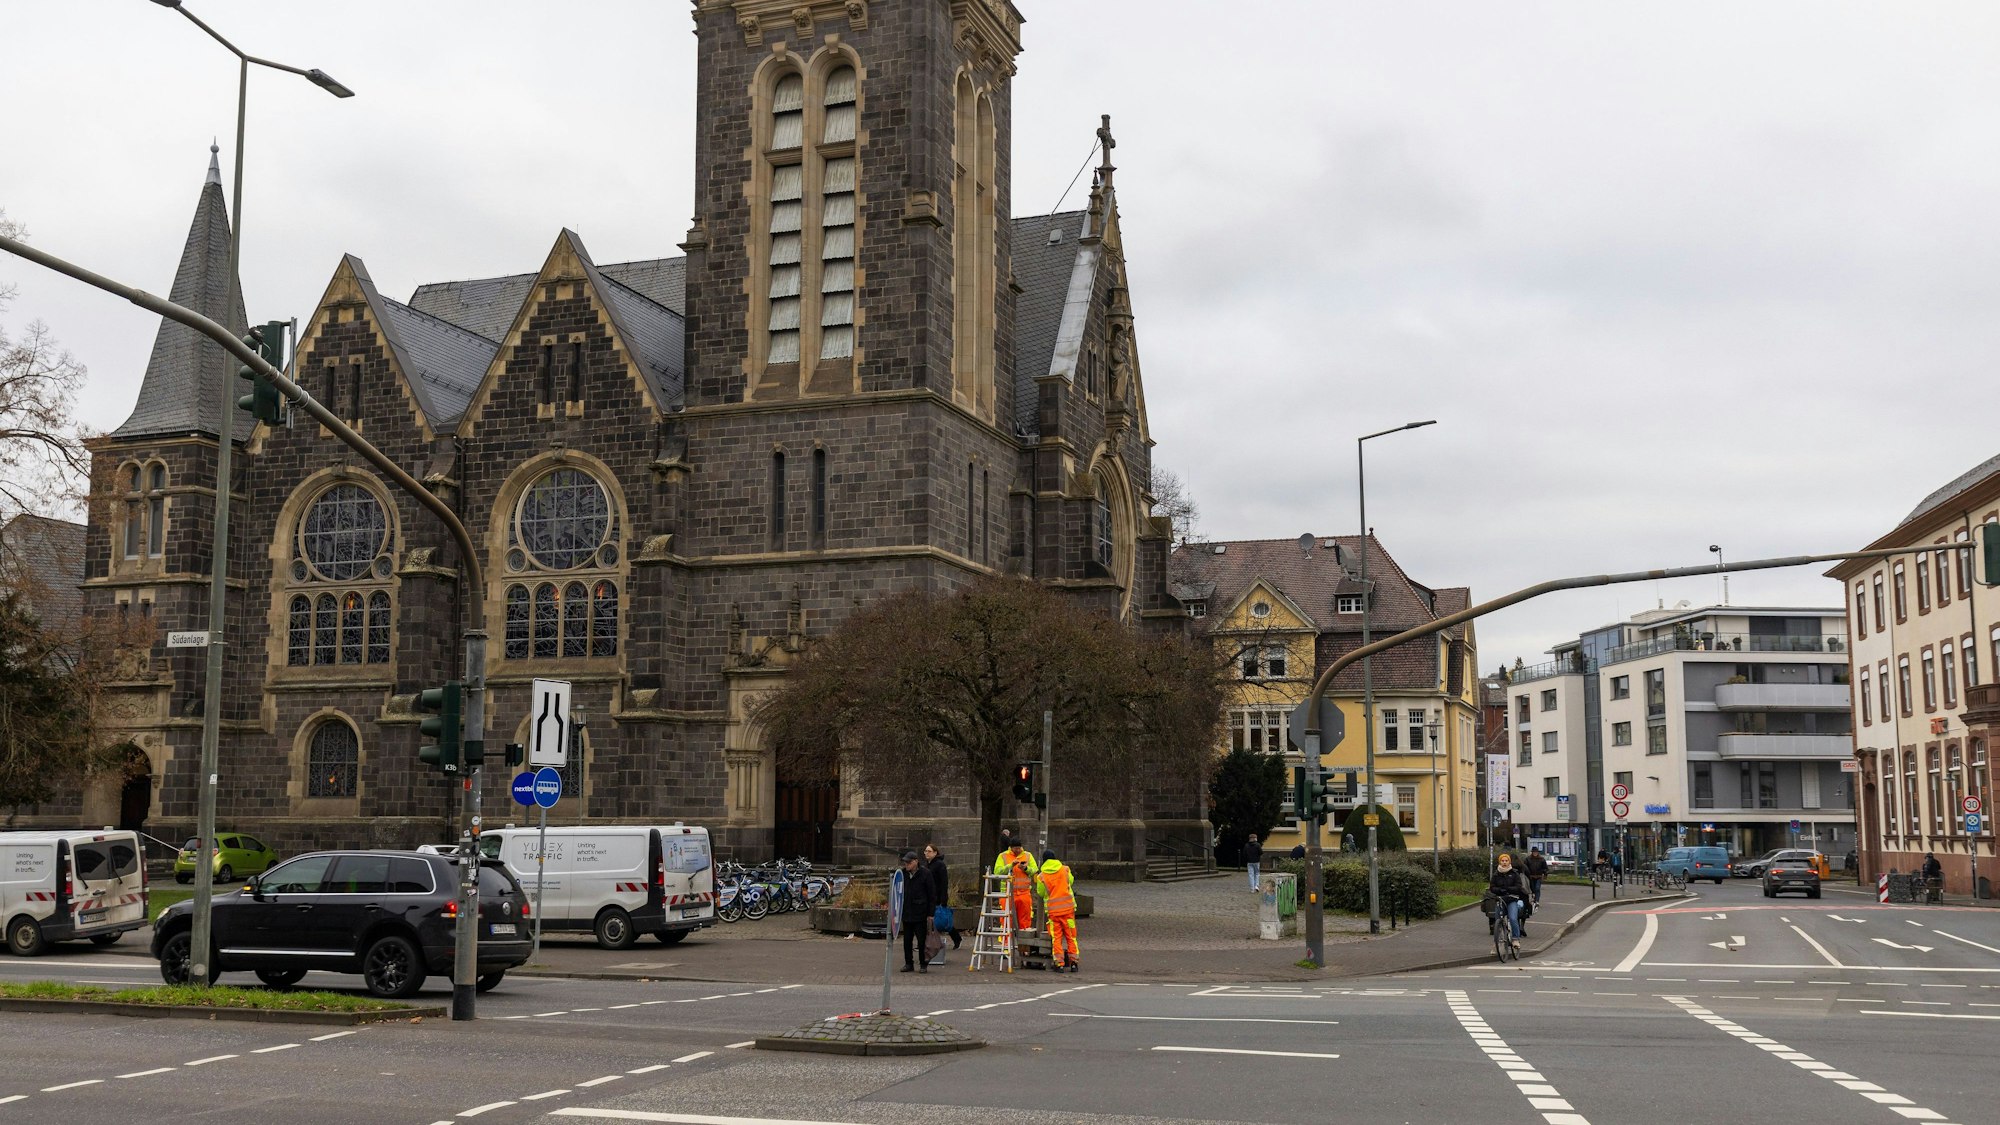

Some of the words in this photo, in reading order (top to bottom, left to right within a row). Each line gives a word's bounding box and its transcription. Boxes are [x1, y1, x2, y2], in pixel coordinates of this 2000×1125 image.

[172, 634, 204, 645] Südanlage
[1615, 788, 1625, 796] 30
[1967, 801, 1978, 809] 30
[577, 842, 596, 850] Uniting
[15, 852, 34, 860] Uniting
